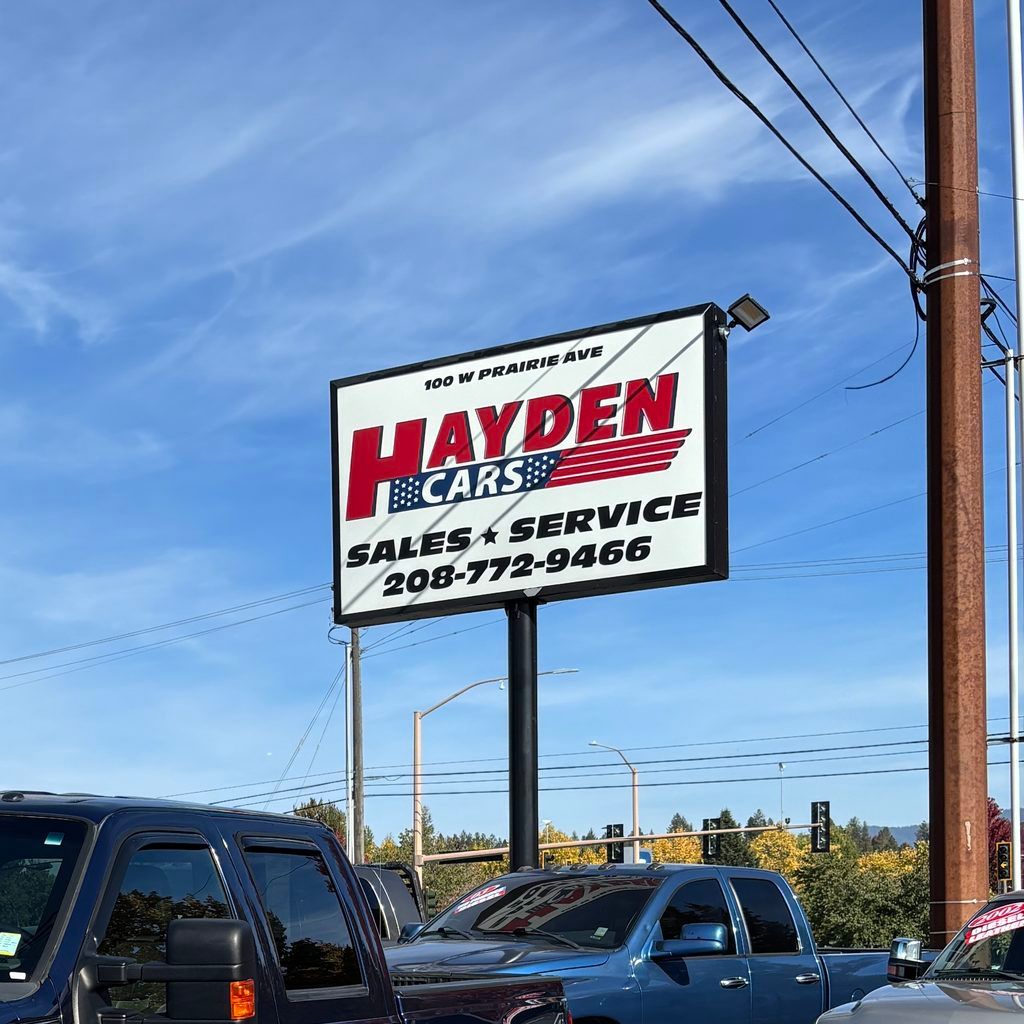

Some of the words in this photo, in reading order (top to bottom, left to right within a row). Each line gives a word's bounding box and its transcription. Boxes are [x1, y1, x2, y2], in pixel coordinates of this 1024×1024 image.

[424, 375, 454, 391] 100
[458, 371, 477, 384] W
[478, 355, 560, 381] PRAIRIE
[562, 346, 603, 364] AVE
[346, 372, 679, 521] HAYDEN
[421, 459, 525, 504] CARS
[346, 527, 472, 568] SALES
[508, 492, 703, 543] SERVICE
[382, 536, 652, 597] 208-772-9466
[971, 912, 1024, 935] DIESEL
